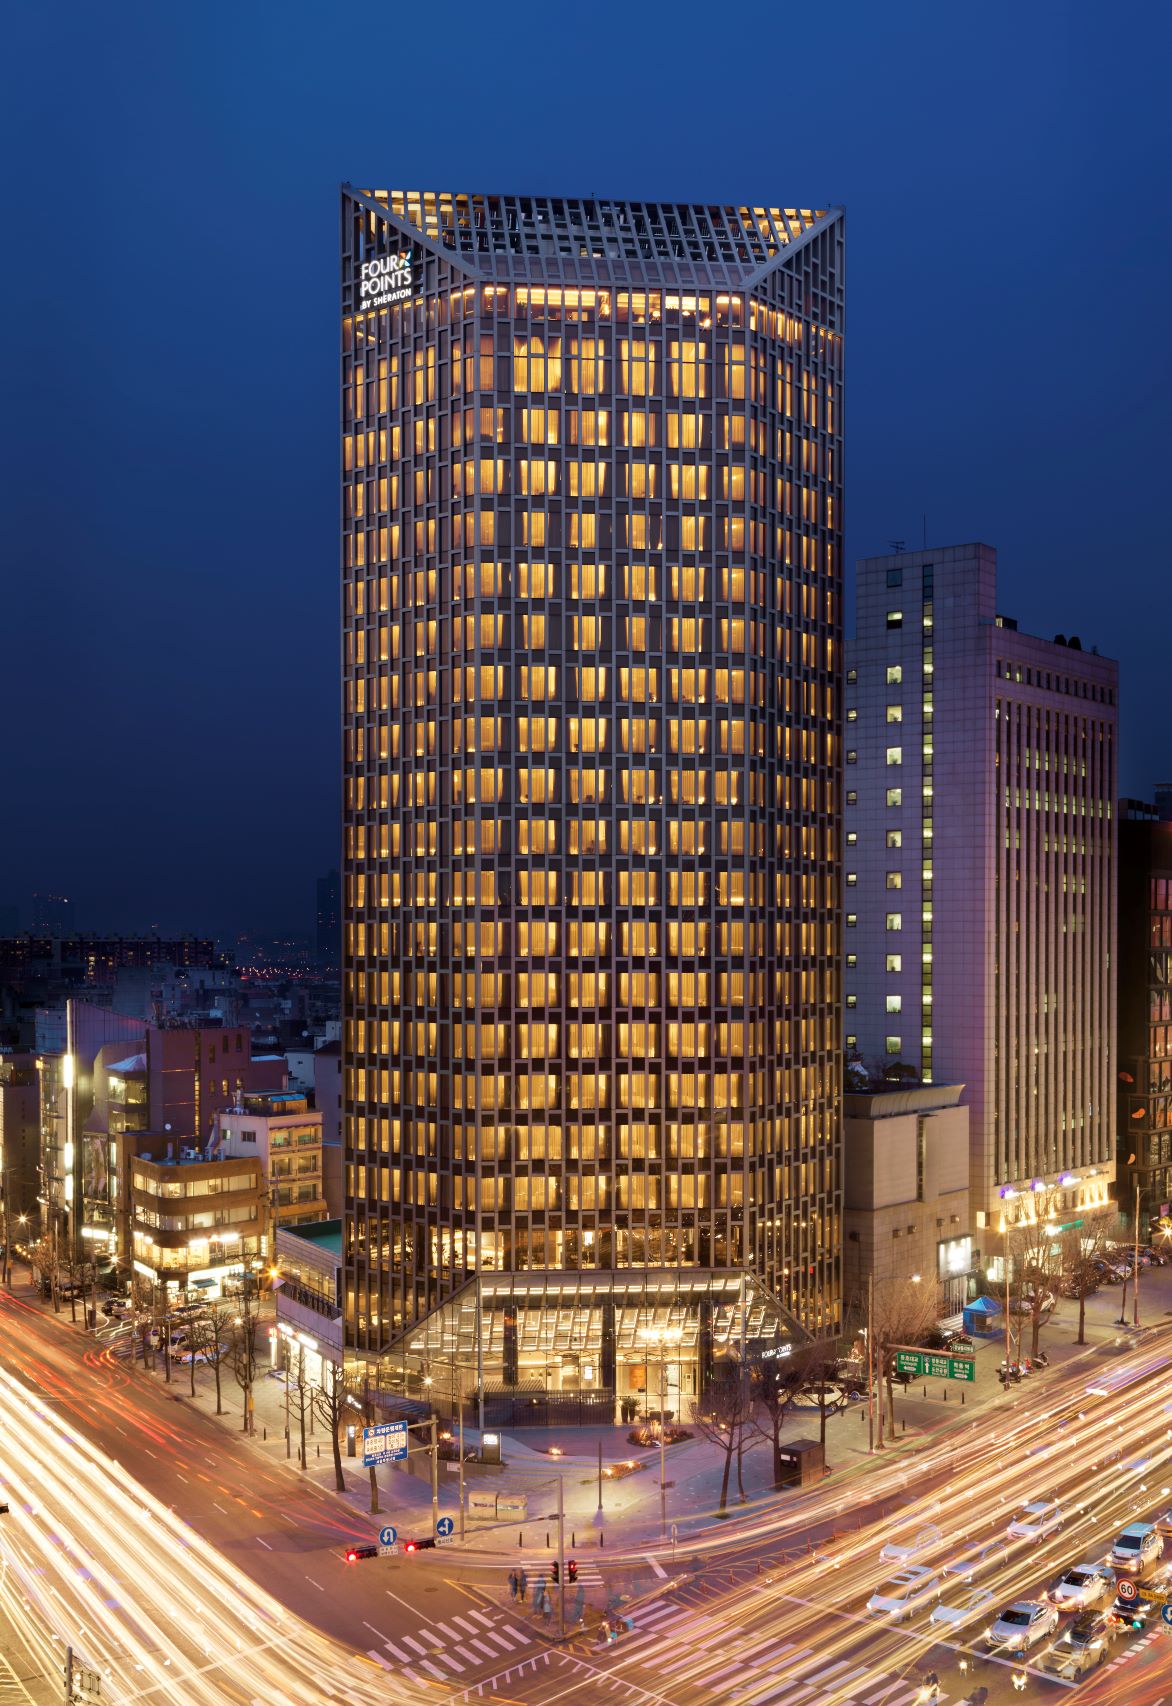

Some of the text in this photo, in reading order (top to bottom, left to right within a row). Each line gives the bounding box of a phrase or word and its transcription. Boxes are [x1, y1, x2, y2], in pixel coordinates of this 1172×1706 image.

[361, 254, 399, 280] FOUR
[361, 268, 412, 297] POINTS
[361, 288, 412, 310] BY SHERATON
[1121, 1584, 1132, 1595] 60
